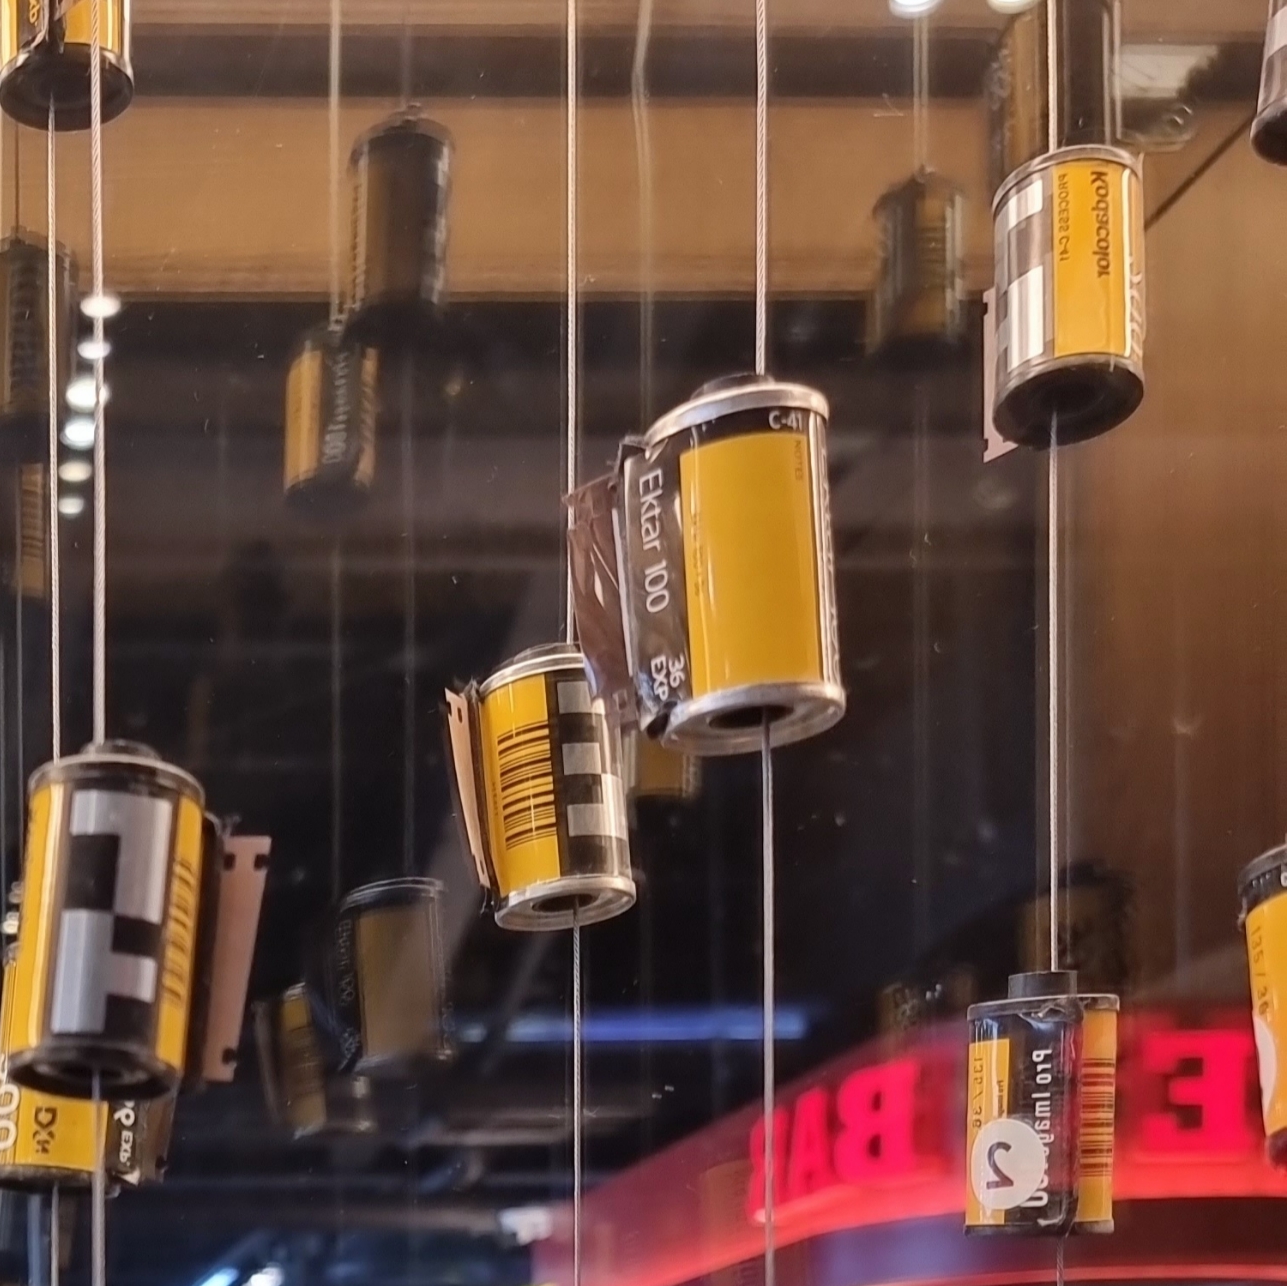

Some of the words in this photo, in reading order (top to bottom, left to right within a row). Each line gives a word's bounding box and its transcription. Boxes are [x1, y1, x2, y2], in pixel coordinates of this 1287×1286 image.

[768, 409, 804, 431] C-41
[638, 467, 665, 553] Ektar
[642, 559, 671, 615] 100
[667, 653, 686, 688] 36
